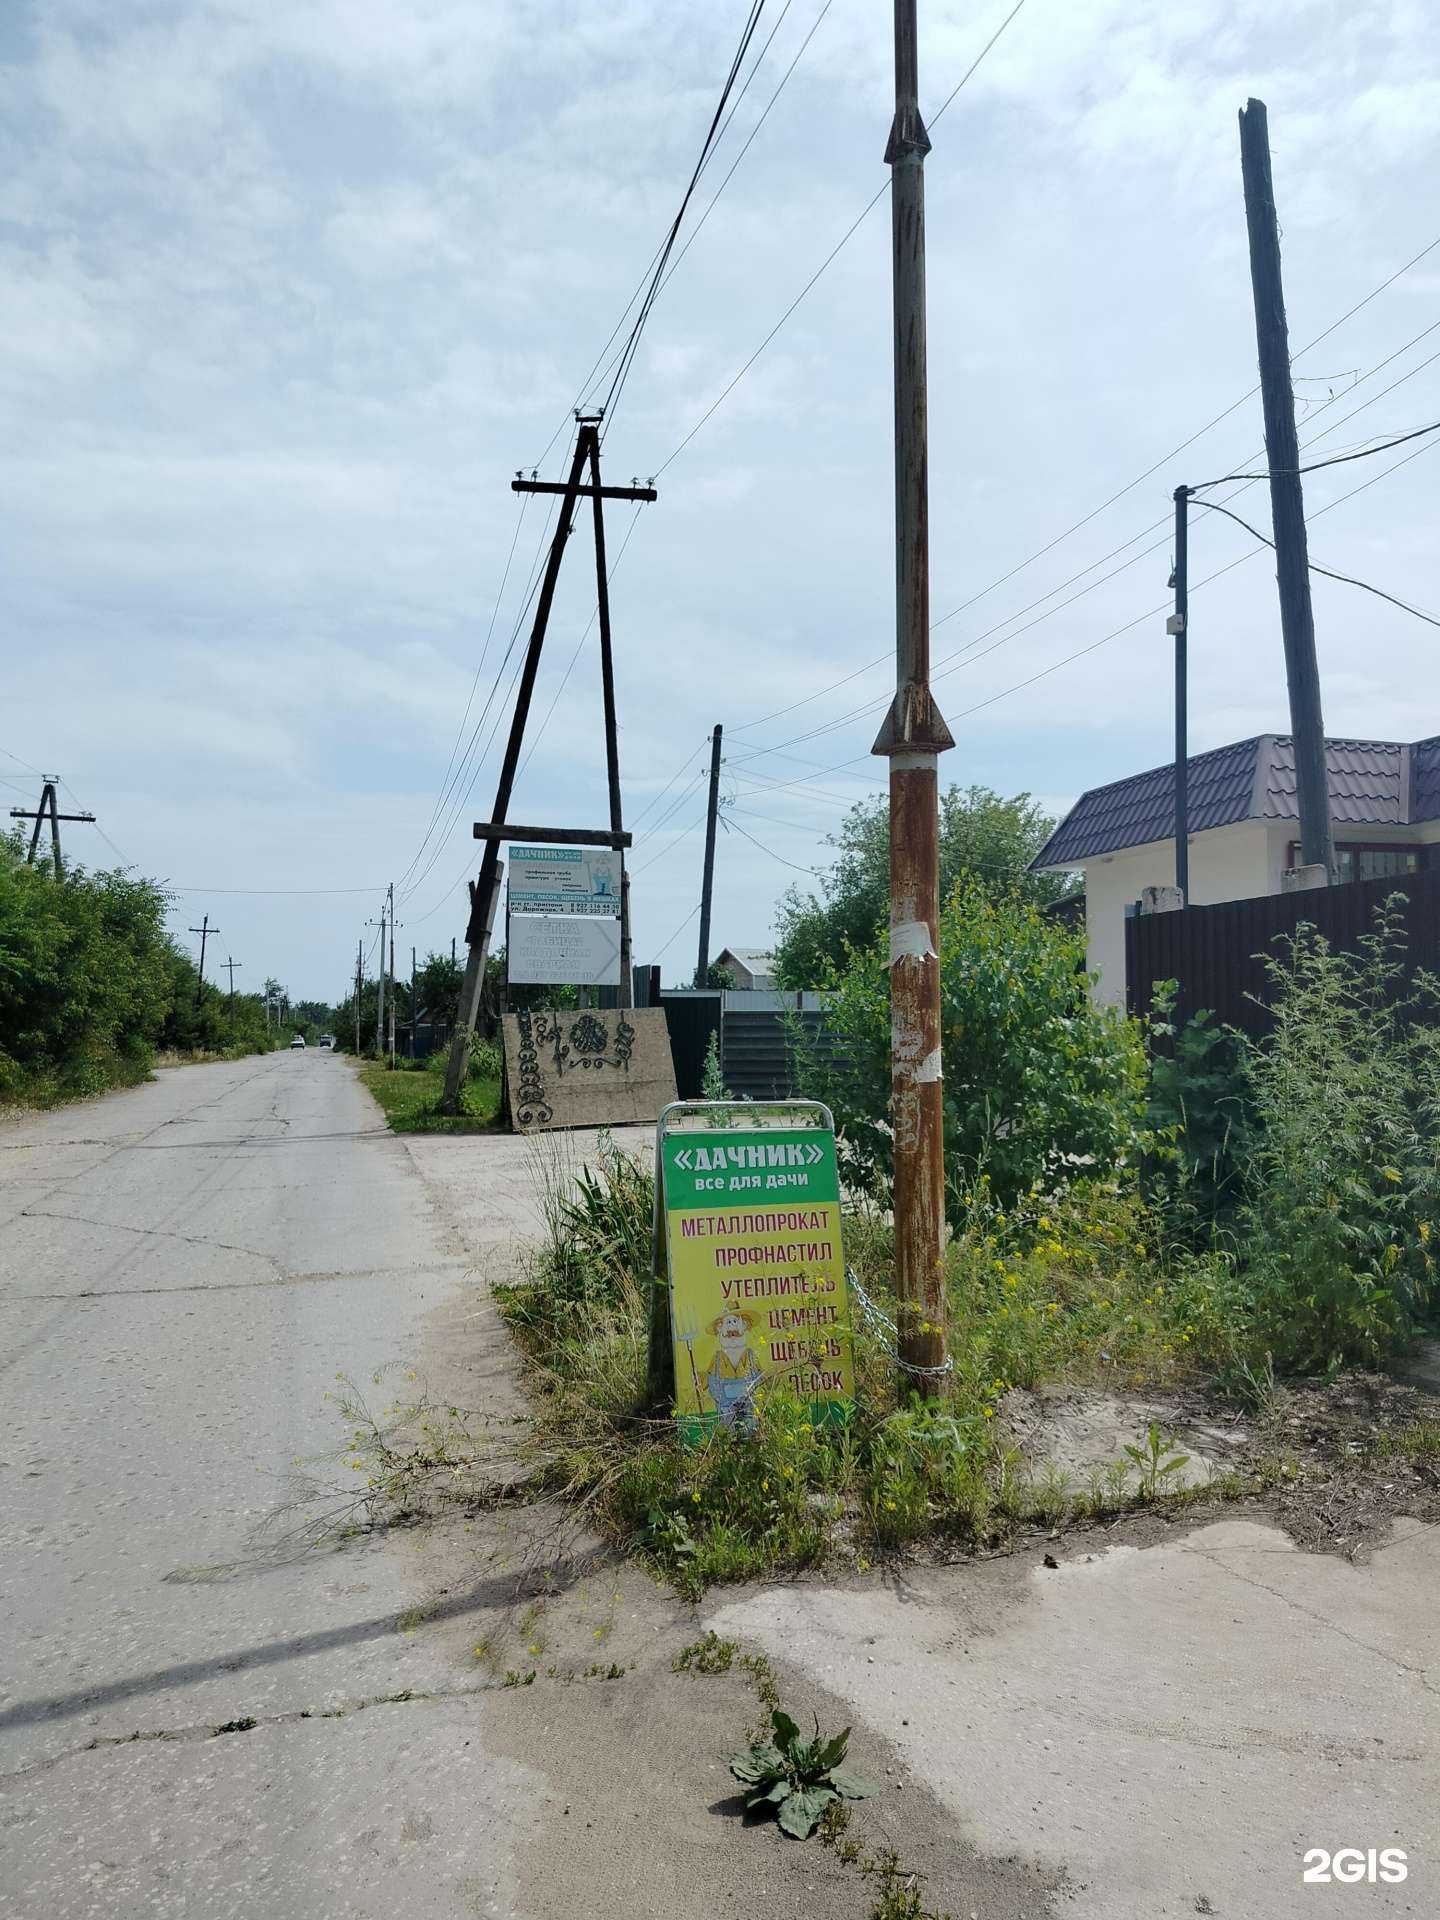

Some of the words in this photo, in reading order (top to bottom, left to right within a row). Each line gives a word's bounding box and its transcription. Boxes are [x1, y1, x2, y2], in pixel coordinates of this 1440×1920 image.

[673, 1143, 824, 1172] «ДАЧНИК»
[695, 1178, 725, 1191] все
[728, 1175, 762, 1191] для
[765, 1172, 809, 1190] дачи
[681, 1211, 829, 1237] МЕТАЛЛОПРОКАТ
[715, 1243, 832, 1267] ПРОФНАСТИЛ
